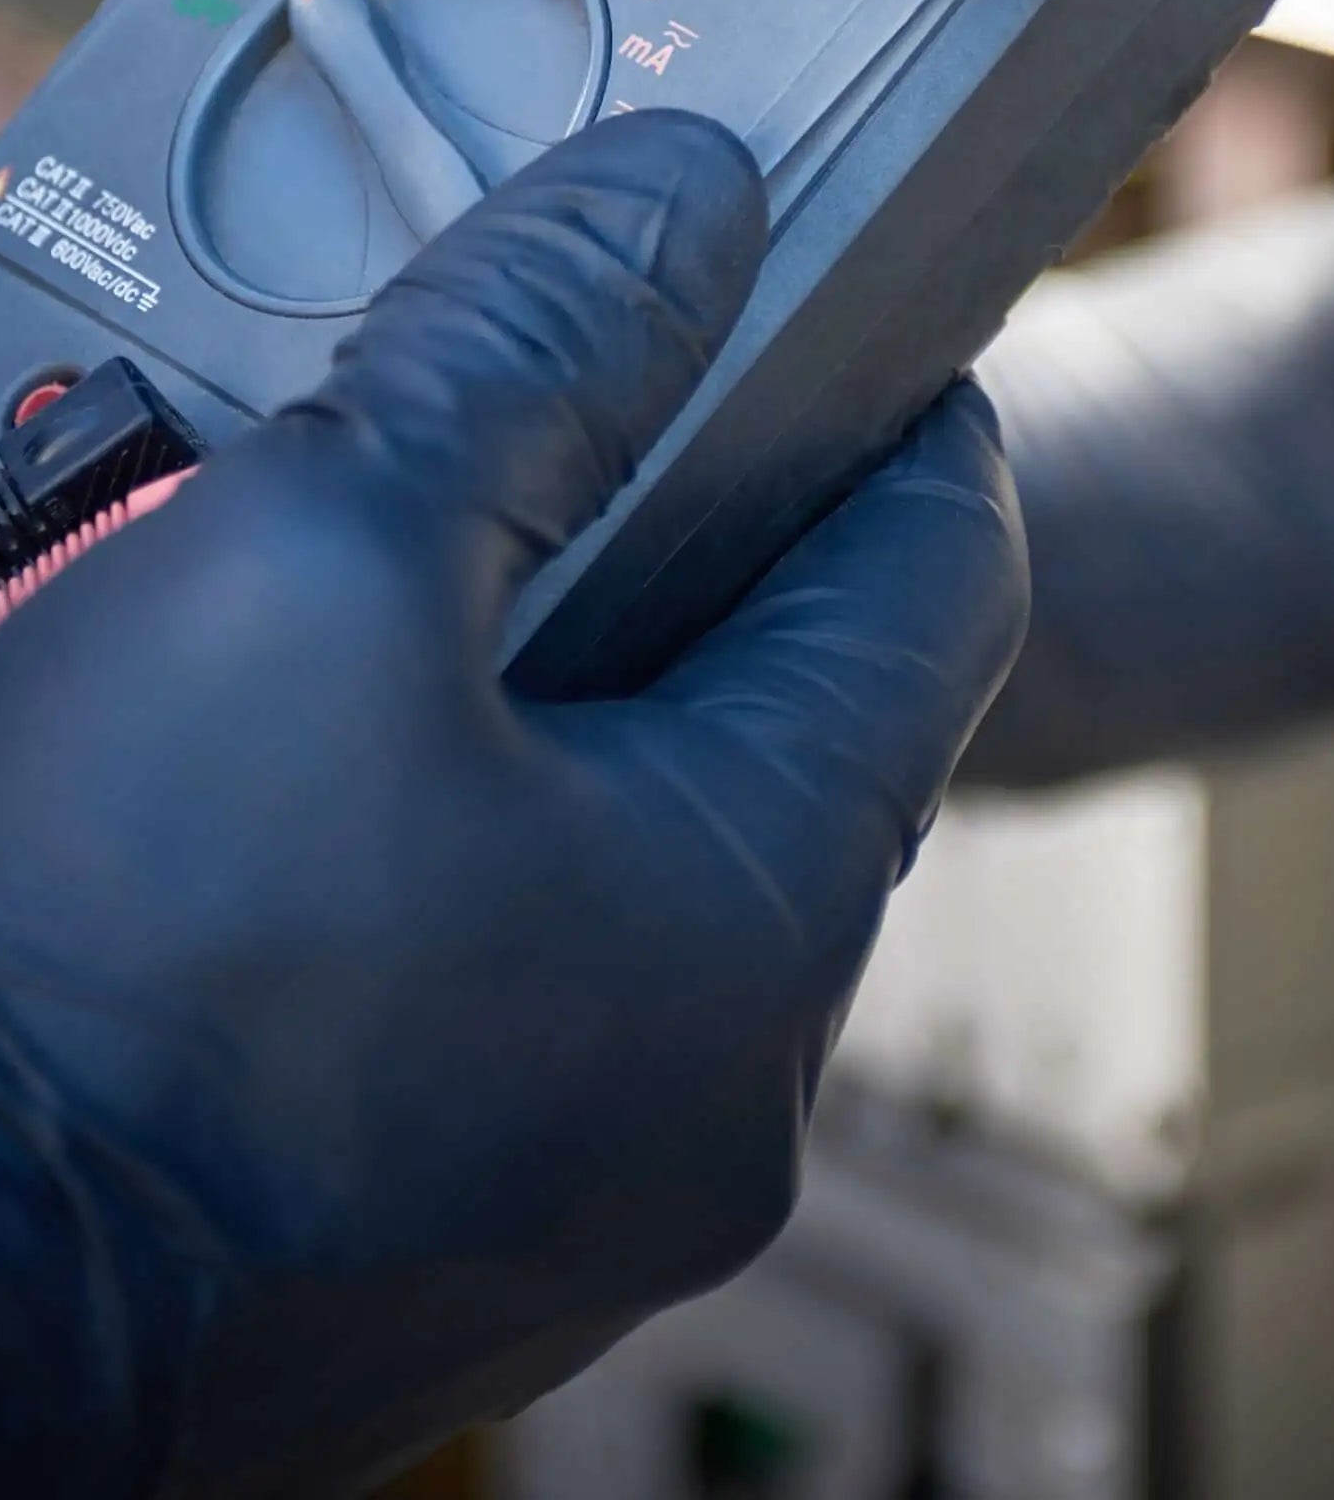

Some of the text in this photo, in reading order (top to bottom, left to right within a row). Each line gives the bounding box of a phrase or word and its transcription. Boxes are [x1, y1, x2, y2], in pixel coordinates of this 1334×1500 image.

[16, 176, 60, 210] CAT
[67, 208, 138, 262] 1000Vdc
[35, 155, 77, 188] CAT
[92, 189, 156, 240] 750Vac
[50, 238, 140, 303] 600Vac/dc
